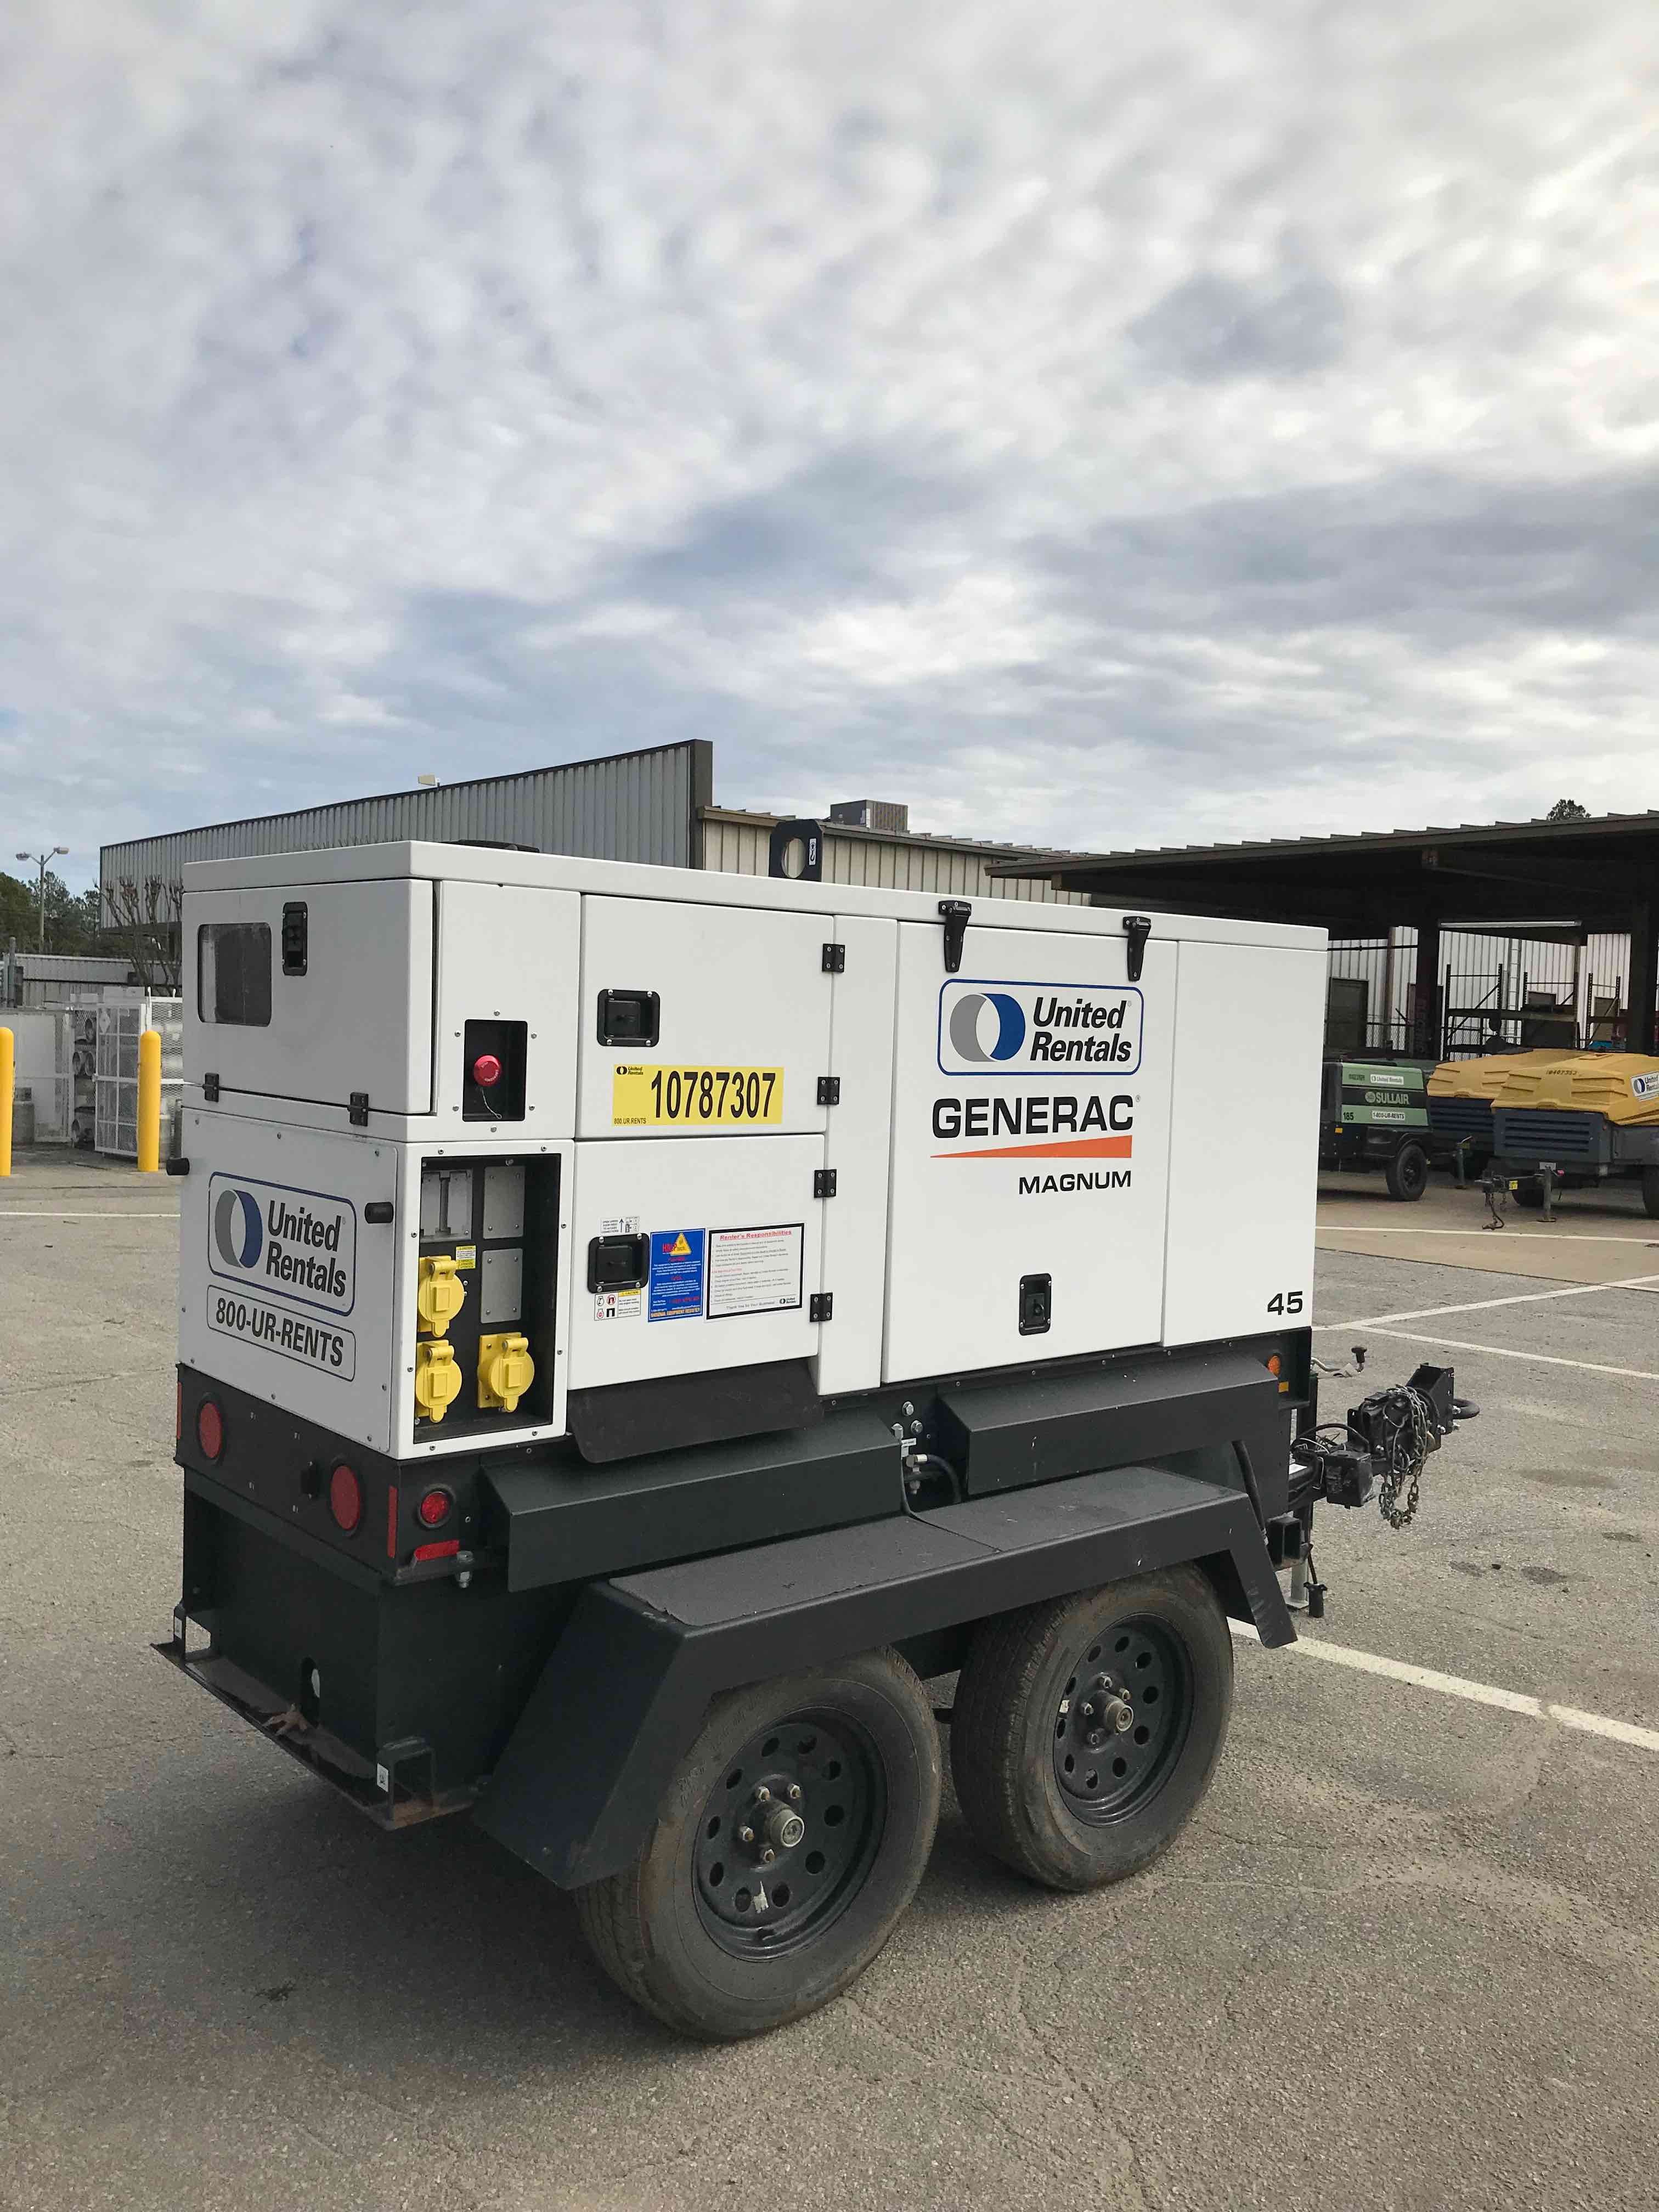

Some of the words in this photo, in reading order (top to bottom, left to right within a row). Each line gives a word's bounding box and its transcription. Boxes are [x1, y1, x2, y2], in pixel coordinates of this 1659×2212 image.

[1032, 996, 1127, 1029] United
[1029, 1031, 1132, 1062] Rentals
[651, 1070, 776, 1119] 10787307
[1376, 1092, 1409, 1105] SULLAIR
[933, 1094, 1133, 1138] GENERAC
[1343, 1111, 1354, 1120] 185
[1019, 1170, 1132, 1195] MAGNUM
[267, 1200, 342, 1252] United
[266, 1240, 347, 1297] Rentals
[1267, 1290, 1303, 1316] 45
[216, 1297, 344, 1367] 800-UR-RENTS
